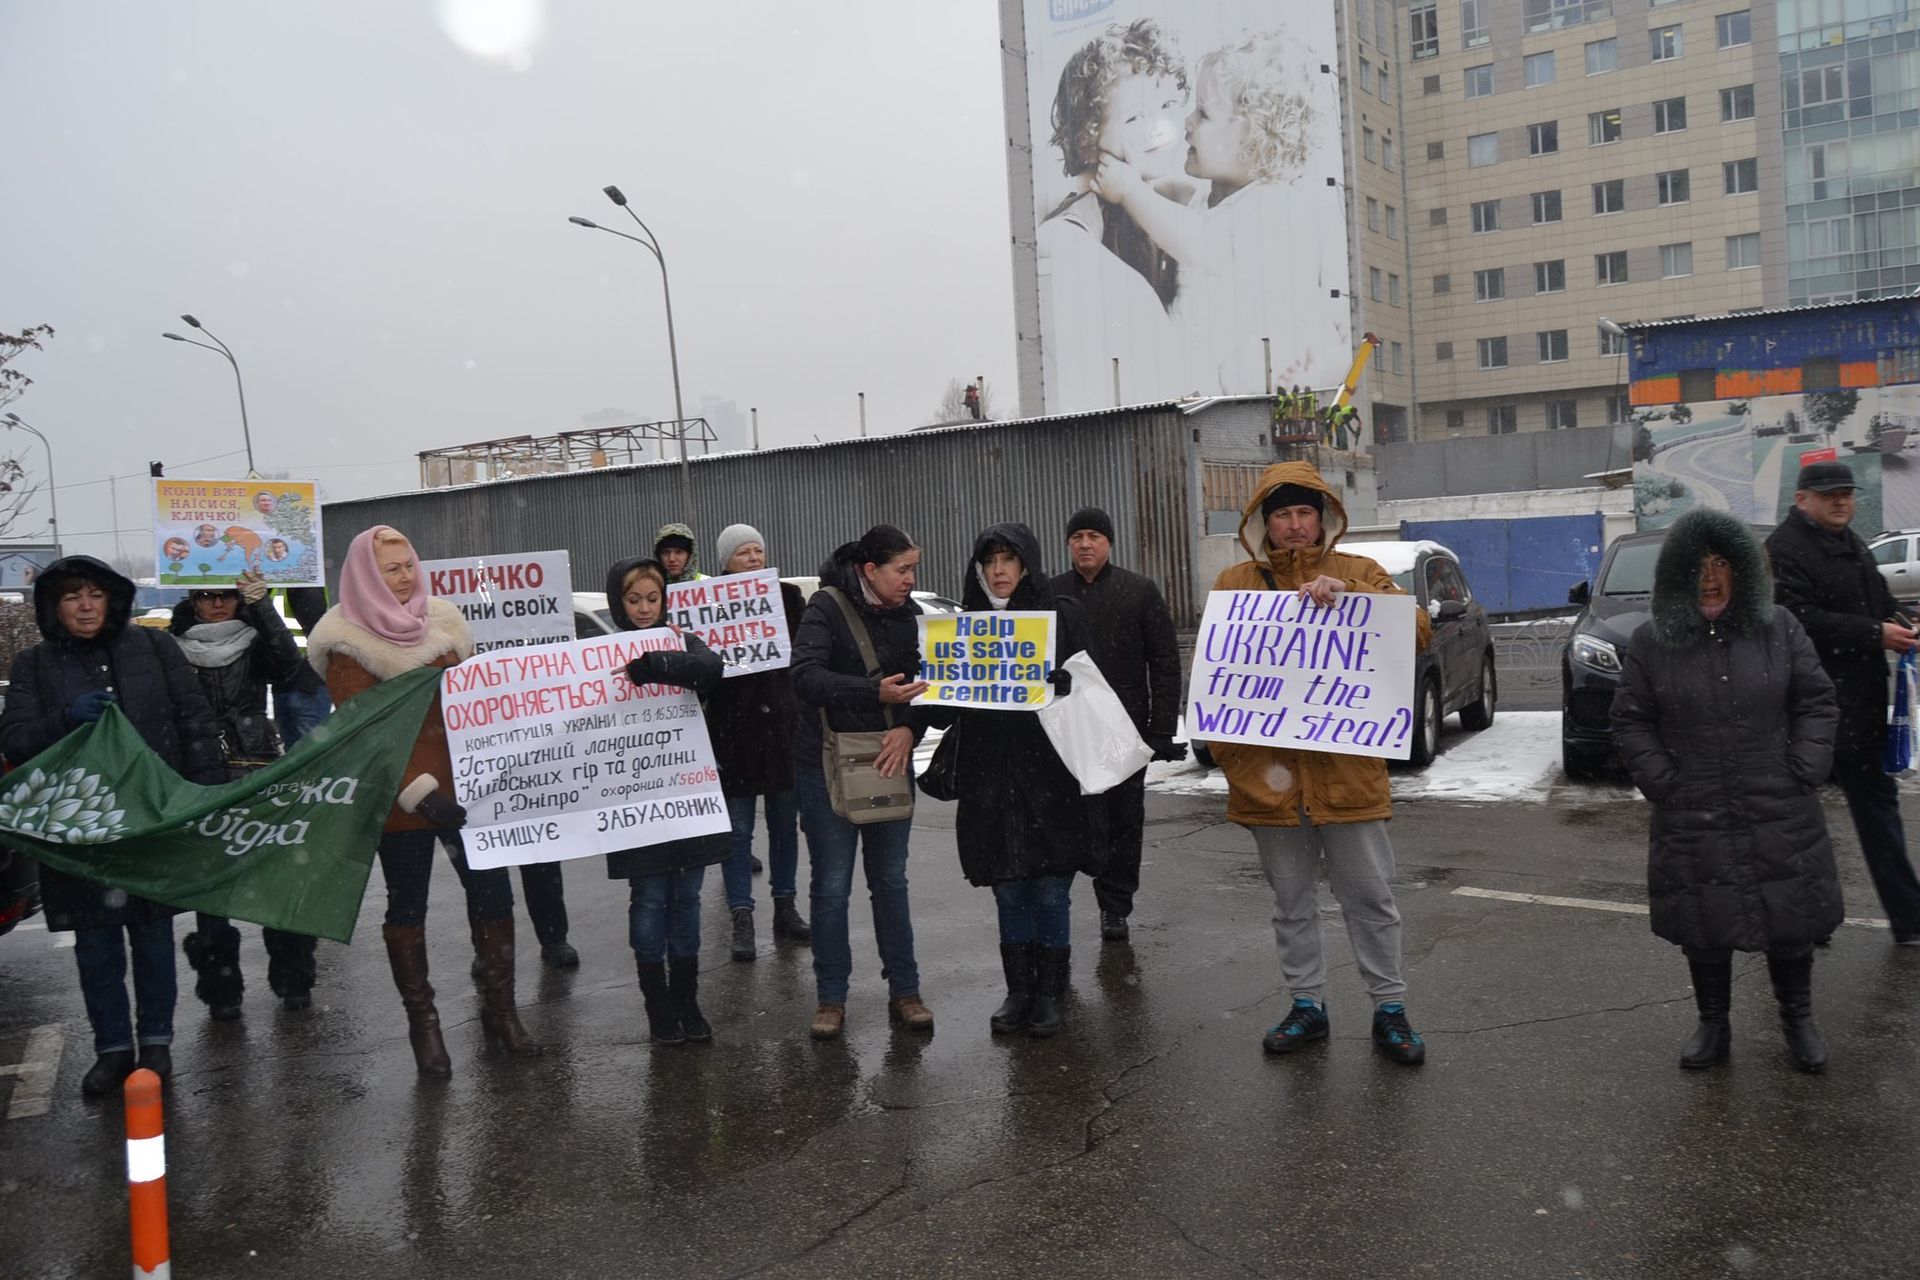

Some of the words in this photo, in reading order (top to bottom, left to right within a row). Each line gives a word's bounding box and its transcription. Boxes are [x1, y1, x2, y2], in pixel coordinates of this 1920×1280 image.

[163, 487, 206, 496] КОЛИ
[213, 488, 246, 496] ВЖЕ
[430, 562, 543, 596] КЛИЧКО
[713, 578, 769, 602] ГЕТЬ
[502, 595, 559, 618] СВОЇХ
[699, 597, 773, 624] ПАРКА
[956, 616, 1015, 638] Help
[935, 641, 966, 659] us
[972, 641, 1036, 659] save
[1205, 623, 1381, 672] UKRAINE
[446, 652, 577, 694] КУЛЬТУРНА
[920, 660, 1051, 681] historical
[939, 684, 1028, 703] centre
[1208, 667, 1285, 701] from
[1303, 674, 1371, 709] the
[446, 680, 608, 731] ОХОРОНЯЄТЬСЯ
[465, 723, 554, 752] КОНСТИТУЦІЯ
[563, 713, 617, 734] УКРАЇНИ
[1293, 707, 1412, 748] steal?
[585, 728, 684, 757] ландшафт
[459, 771, 563, 802] Київських
[573, 762, 599, 783] гір
[604, 760, 627, 775] та
[632, 749, 697, 779] долини
[601, 777, 664, 800] охороний
[475, 822, 560, 851] ЗНИЩУЄ
[597, 796, 723, 832] ЗАБУДОВНИК
